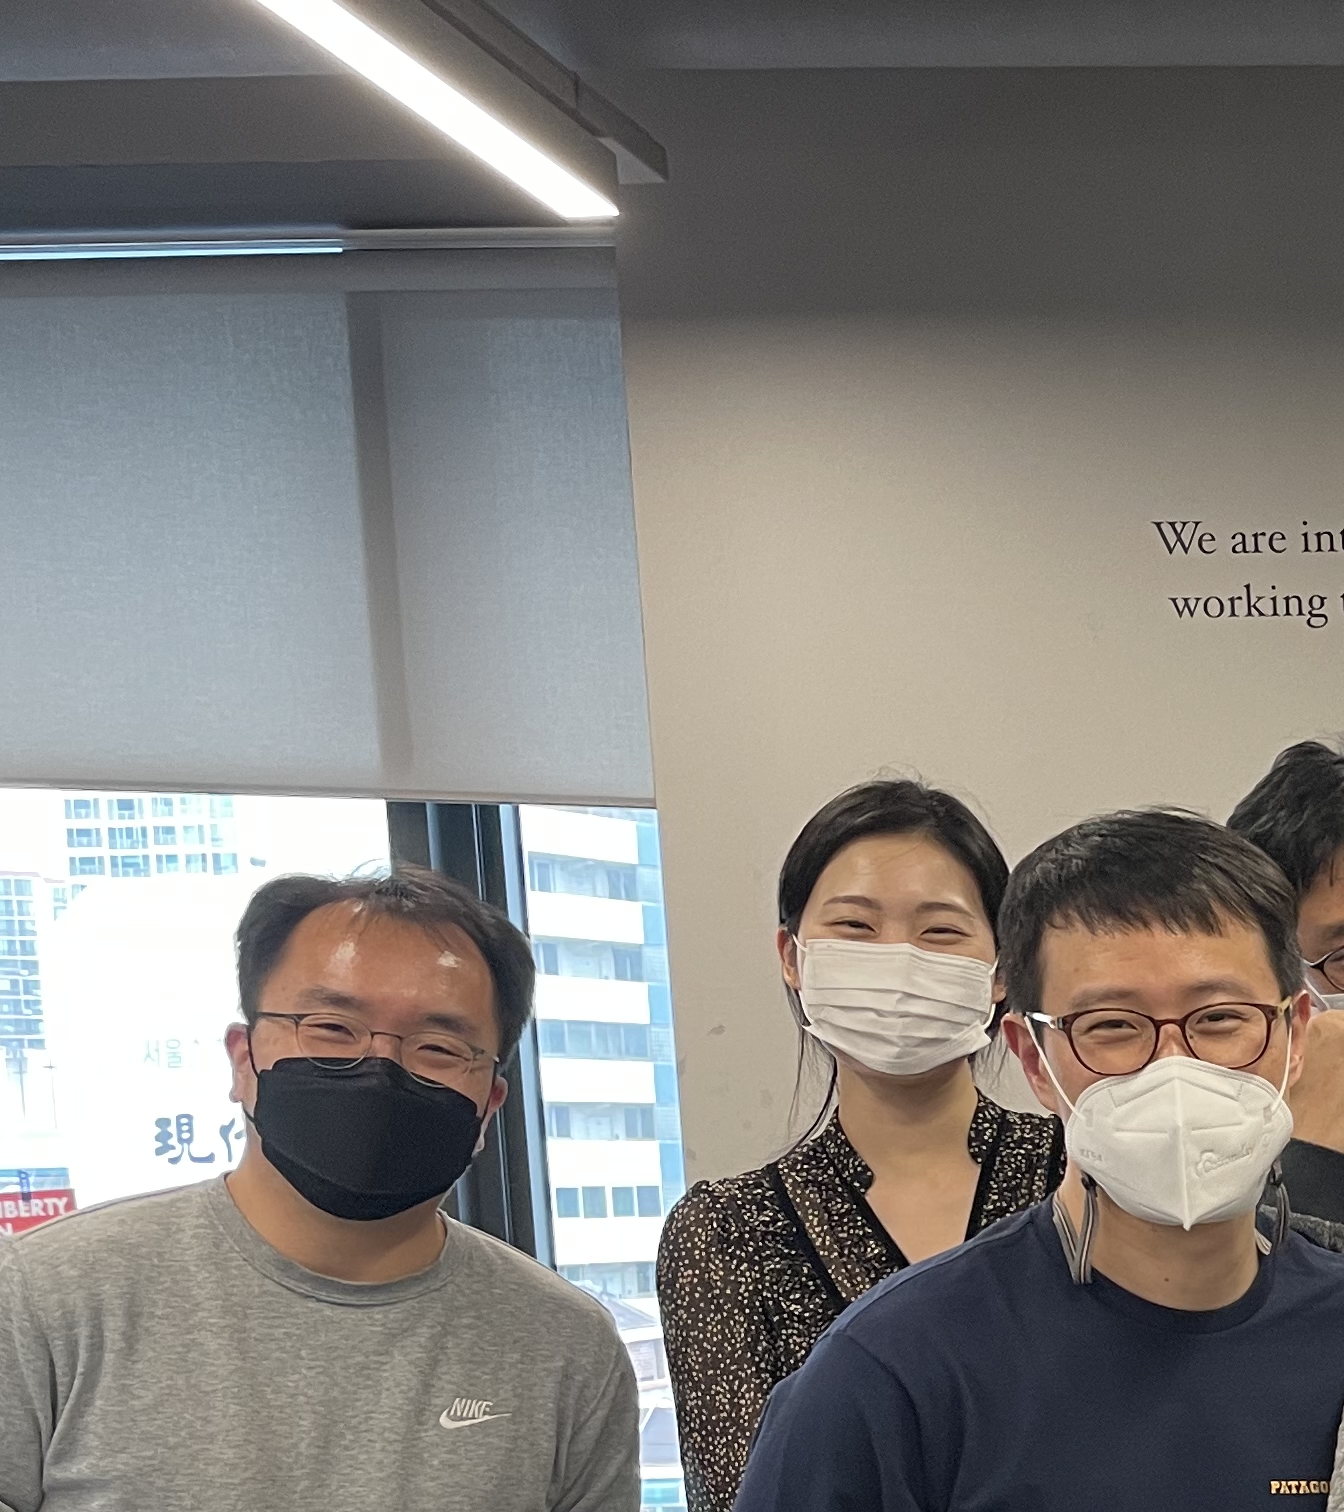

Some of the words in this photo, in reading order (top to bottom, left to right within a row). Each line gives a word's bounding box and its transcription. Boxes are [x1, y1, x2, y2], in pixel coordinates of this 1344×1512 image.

[1151, 520, 1217, 555] We
[1230, 531, 1287, 554] are
[1169, 583, 1328, 628] working
[449, 1397, 494, 1420] NIKE
